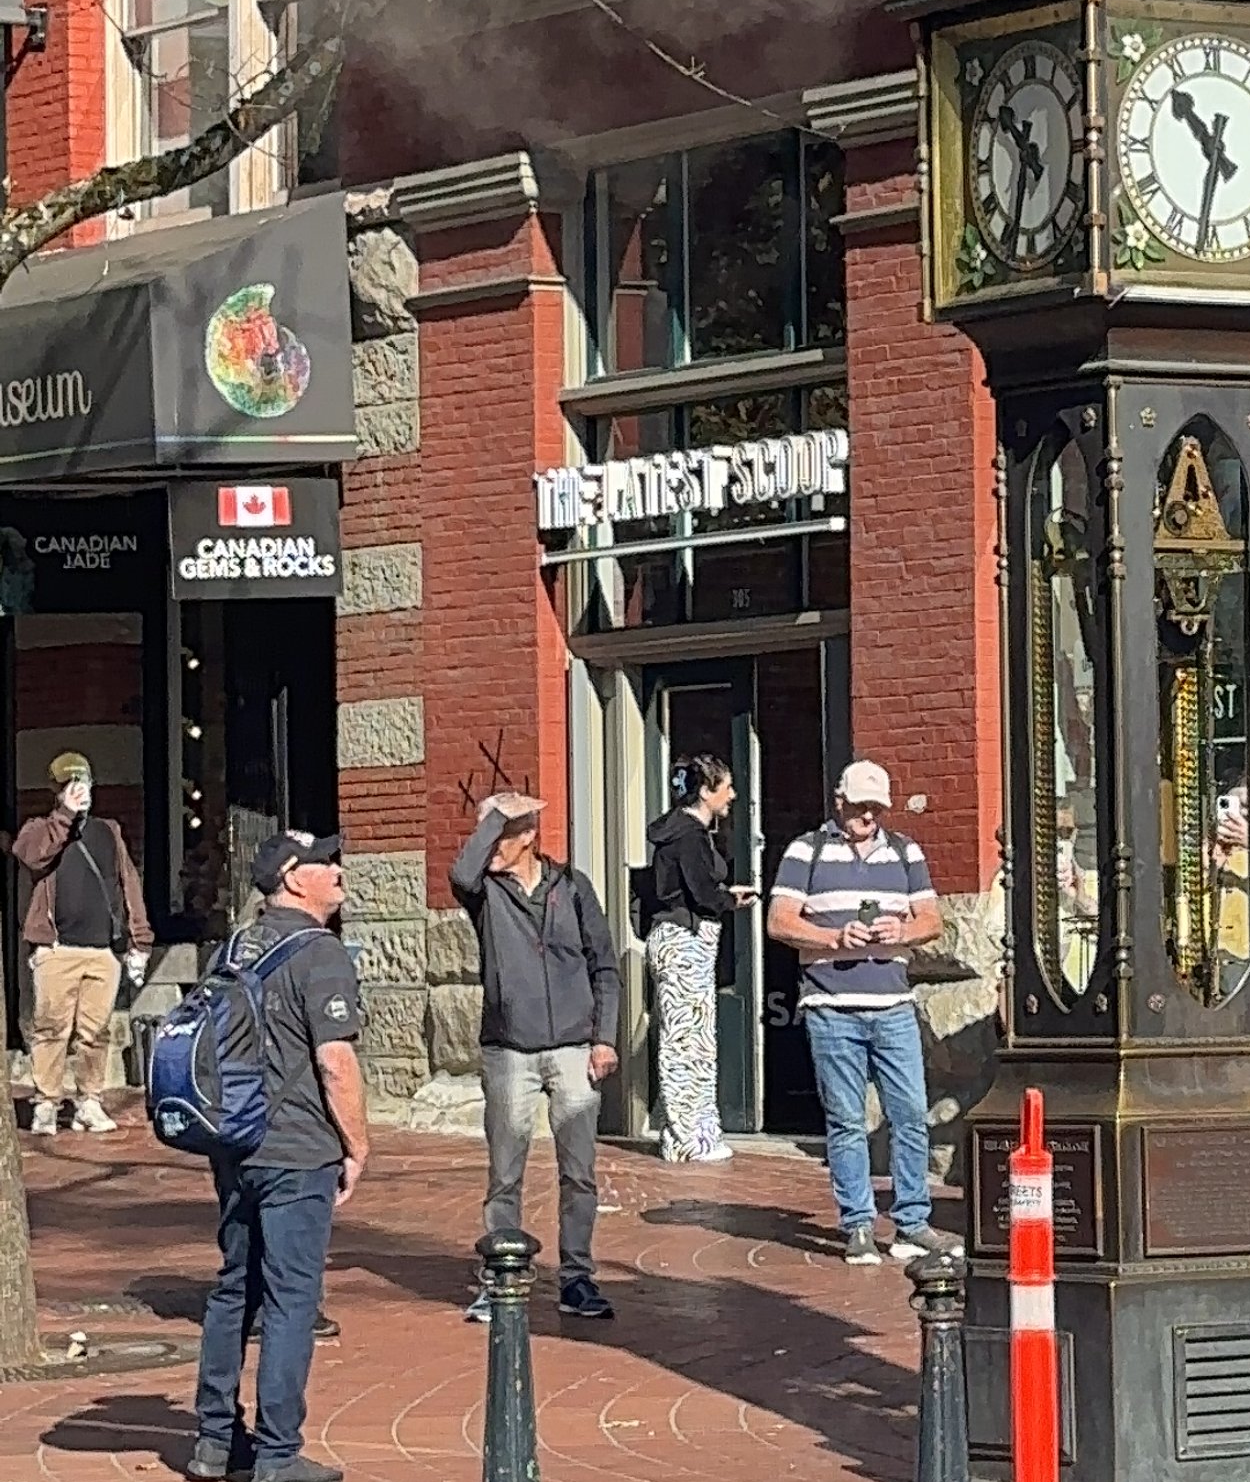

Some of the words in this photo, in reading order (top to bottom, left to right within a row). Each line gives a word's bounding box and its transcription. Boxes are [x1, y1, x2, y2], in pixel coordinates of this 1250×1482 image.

[732, 429, 848, 504] SCOOP
[35, 535, 137, 553] CANADIAN
[198, 537, 315, 559] CANADIAN
[63, 552, 111, 569] JADE
[179, 557, 243, 579] GEMS
[244, 557, 261, 578] &
[263, 555, 335, 576] ROCKS
